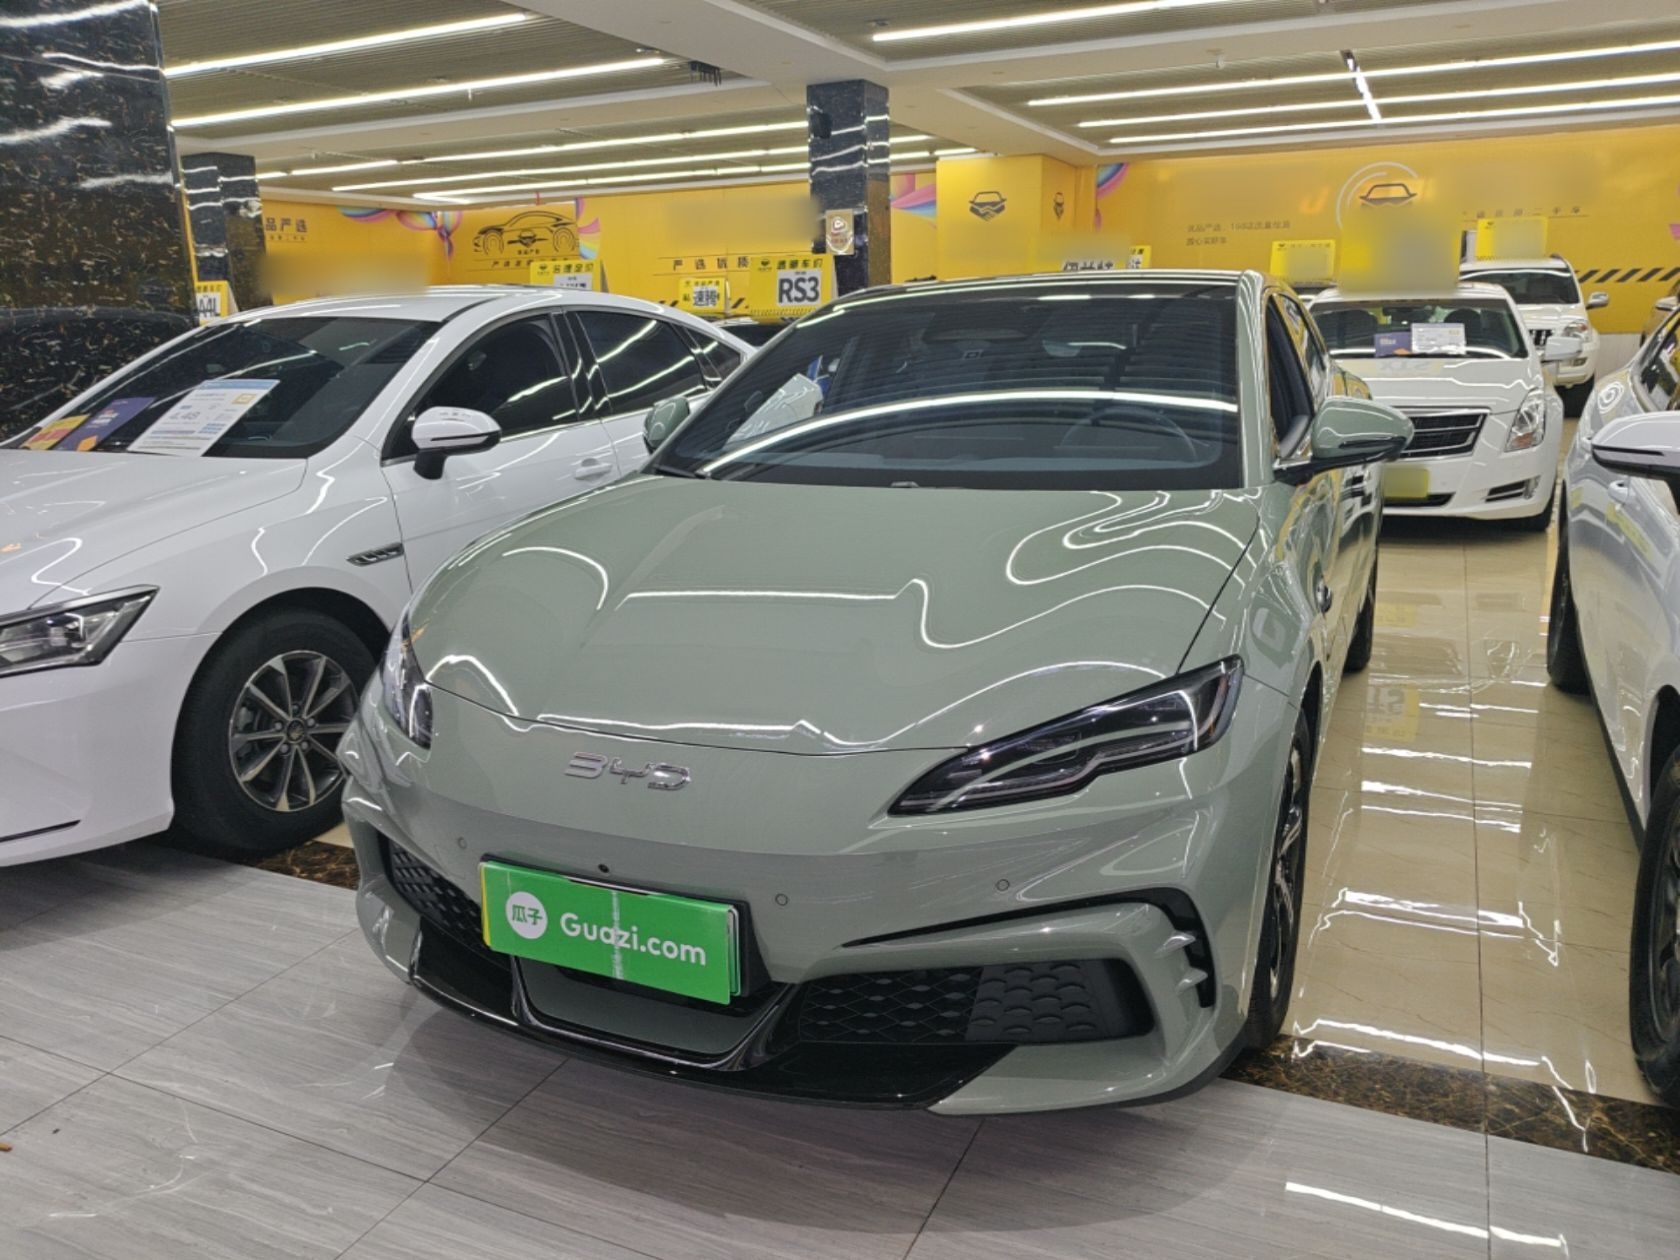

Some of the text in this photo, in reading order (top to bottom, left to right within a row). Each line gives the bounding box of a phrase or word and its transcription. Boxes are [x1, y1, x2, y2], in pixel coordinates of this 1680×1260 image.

[778, 276, 820, 304] RS3
[512, 904, 543, 926] 瓜子
[559, 912, 707, 966] Guazi.com
